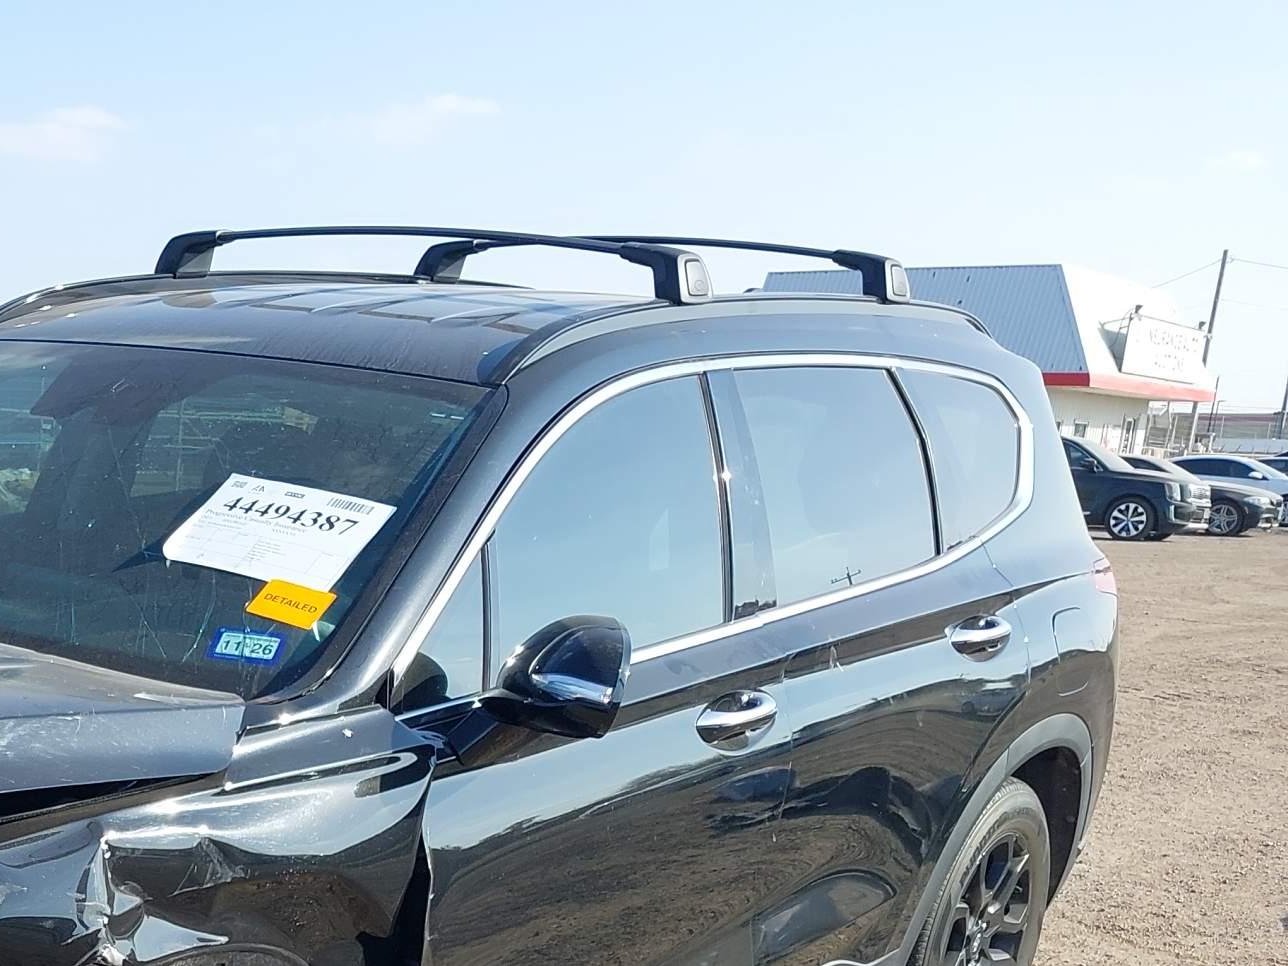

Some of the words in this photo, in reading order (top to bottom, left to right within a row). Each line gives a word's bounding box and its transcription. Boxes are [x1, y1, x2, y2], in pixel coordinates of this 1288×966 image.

[223, 496, 358, 535] 44494387
[264, 593, 317, 614] DETAILED
[223, 639, 242, 651] 11
[250, 642, 274, 656] 26
